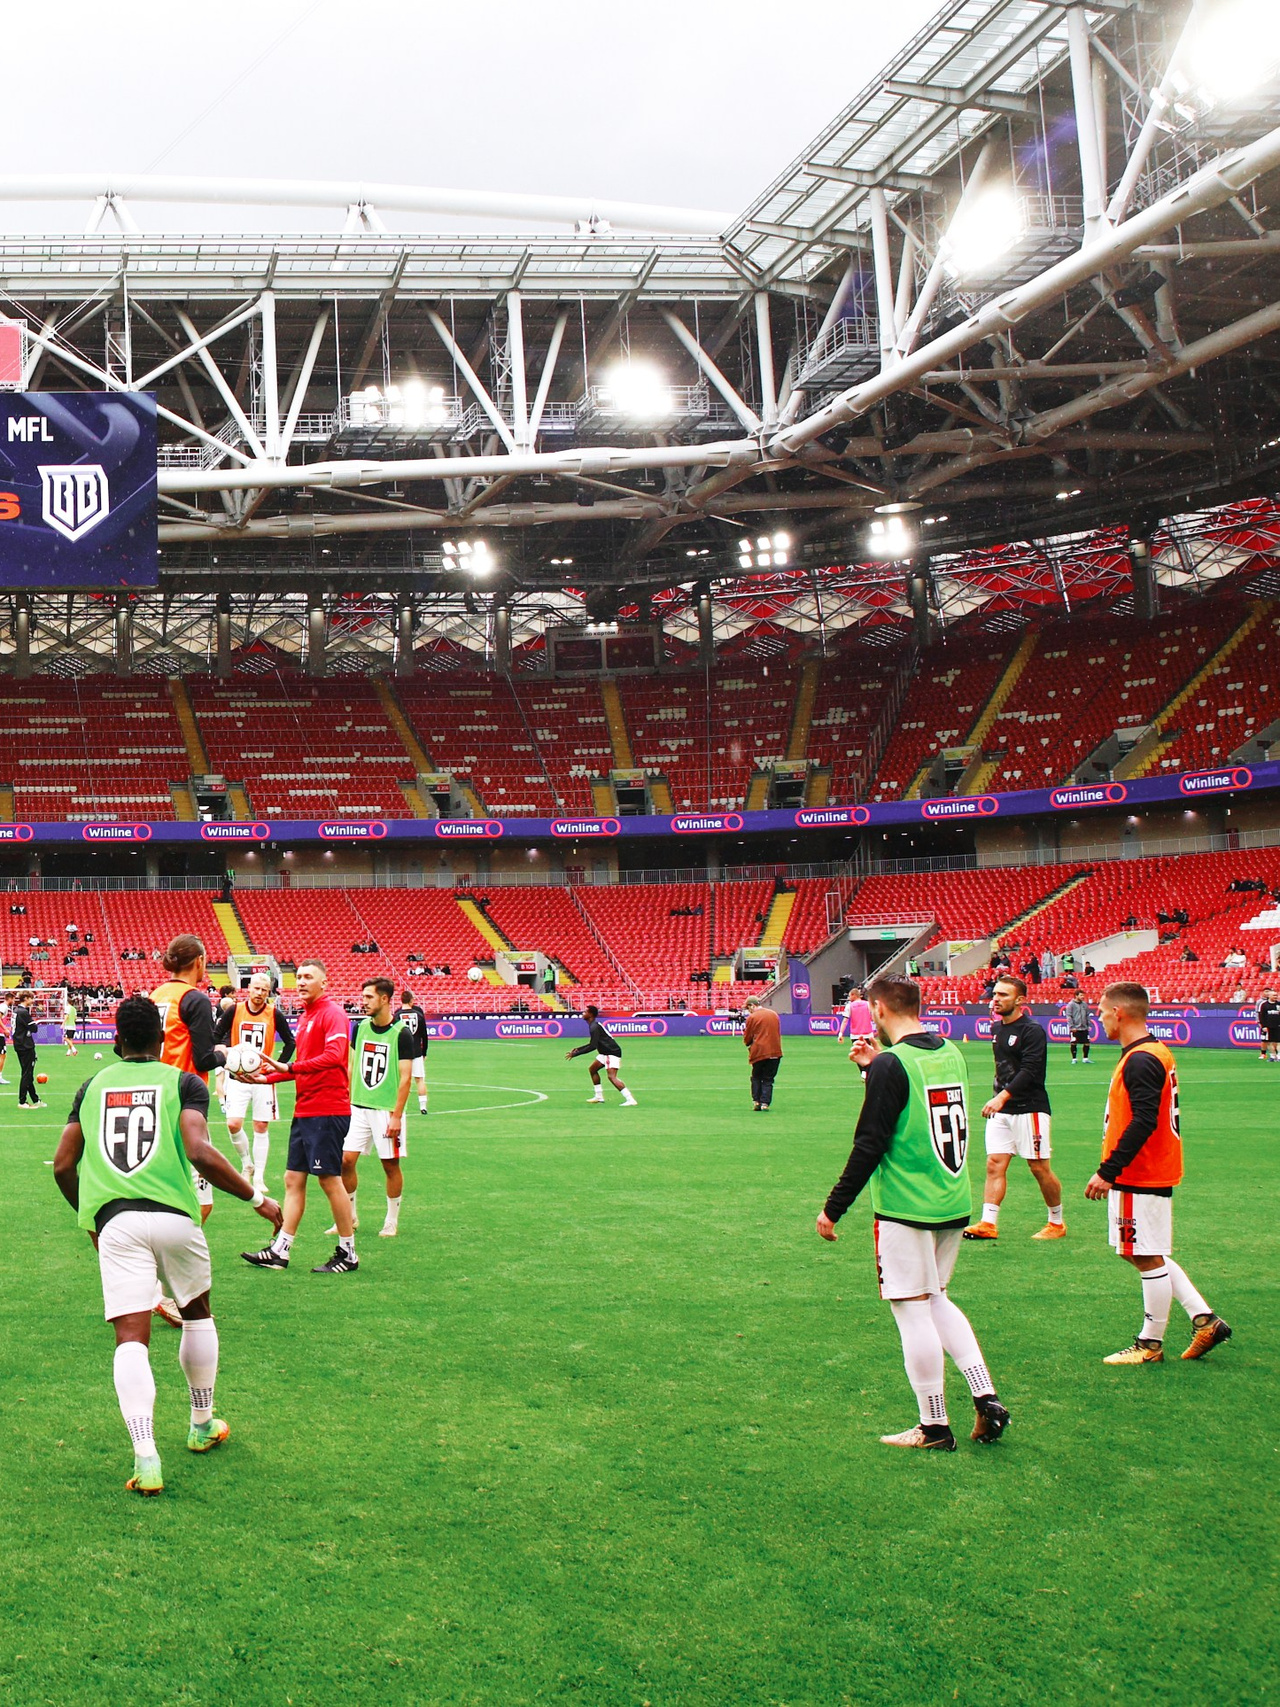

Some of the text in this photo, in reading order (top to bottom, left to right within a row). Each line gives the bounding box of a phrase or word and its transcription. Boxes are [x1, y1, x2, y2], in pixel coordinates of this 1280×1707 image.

[7, 416, 54, 442] MFL
[1184, 775, 1230, 790] Winline
[1056, 790, 1104, 804] Winline
[927, 801, 976, 815] Winline
[801, 812, 848, 824] Winline
[324, 825, 367, 836] Winline
[441, 824, 484, 835] Winline
[556, 822, 600, 833] Winline
[677, 819, 722, 830] Winline
[88, 827, 132, 838] Winline
[207, 826, 250, 837] Winline
[501, 1024, 543, 1034] Winline
[606, 1022, 649, 1033] Winline
[810, 1020, 831, 1030] Winline
[363, 1050, 388, 1085] FC
[107, 1091, 154, 1106] СИНДЕКАТ
[105, 1107, 156, 1166] FC
[930, 1104, 967, 1169] FC
[1118, 1226, 1136, 1243] 12
